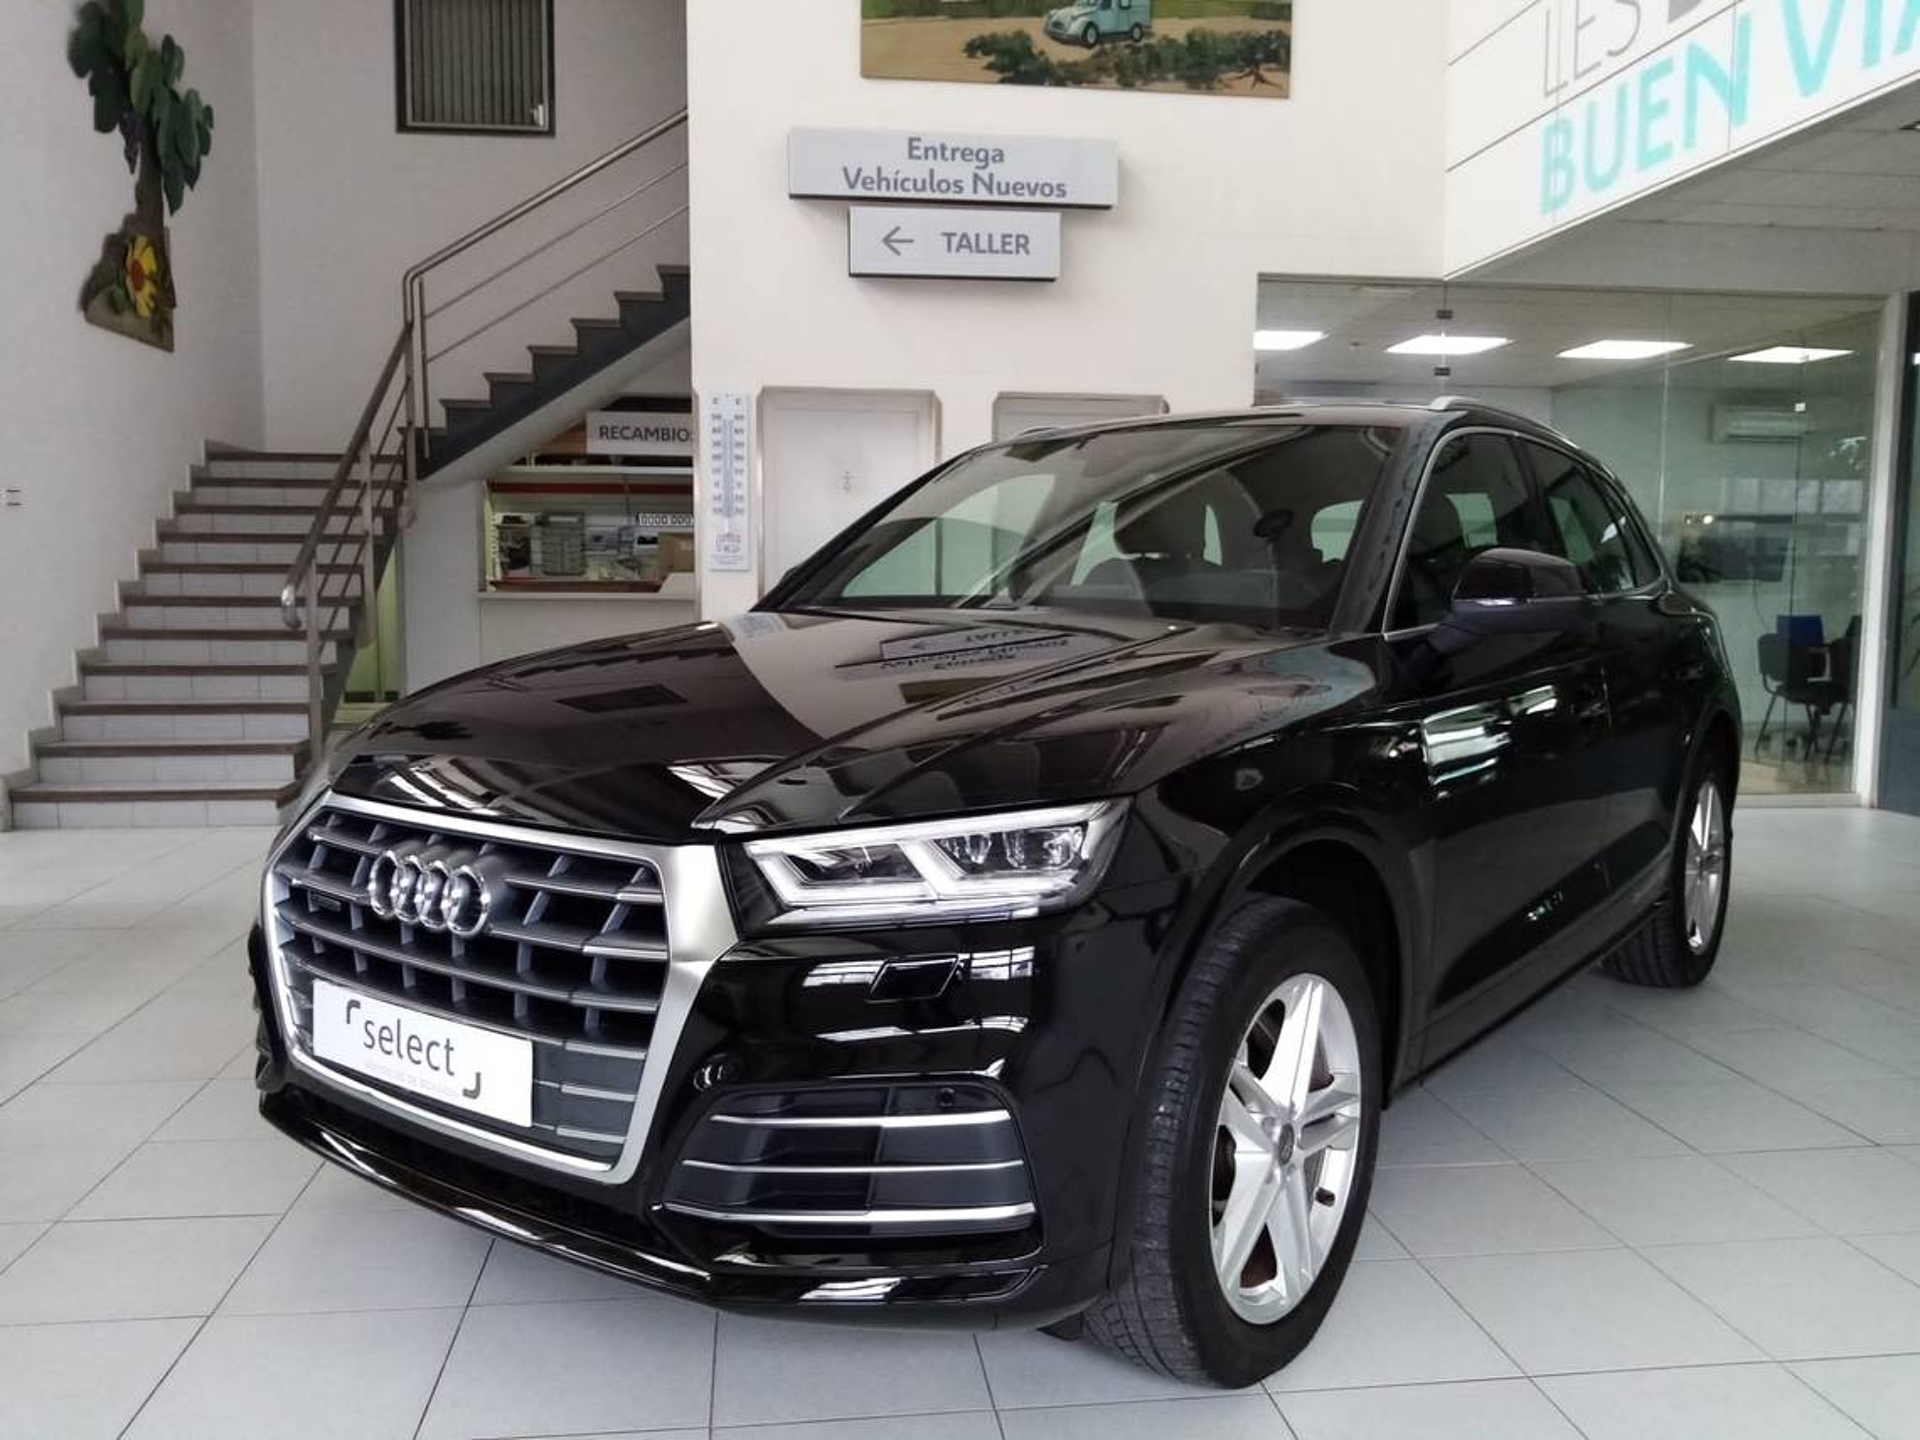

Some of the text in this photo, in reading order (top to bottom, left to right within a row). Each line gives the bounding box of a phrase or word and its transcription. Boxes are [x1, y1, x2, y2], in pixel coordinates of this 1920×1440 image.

[1540, 11, 1752, 216] BUEN
[907, 137, 1005, 170] Entrega
[843, 166, 1067, 198] Vehículos Nuevos
[941, 232, 1031, 256] TALLER
[599, 425, 692, 442] RECAMBIO
[363, 1018, 455, 1077] select
